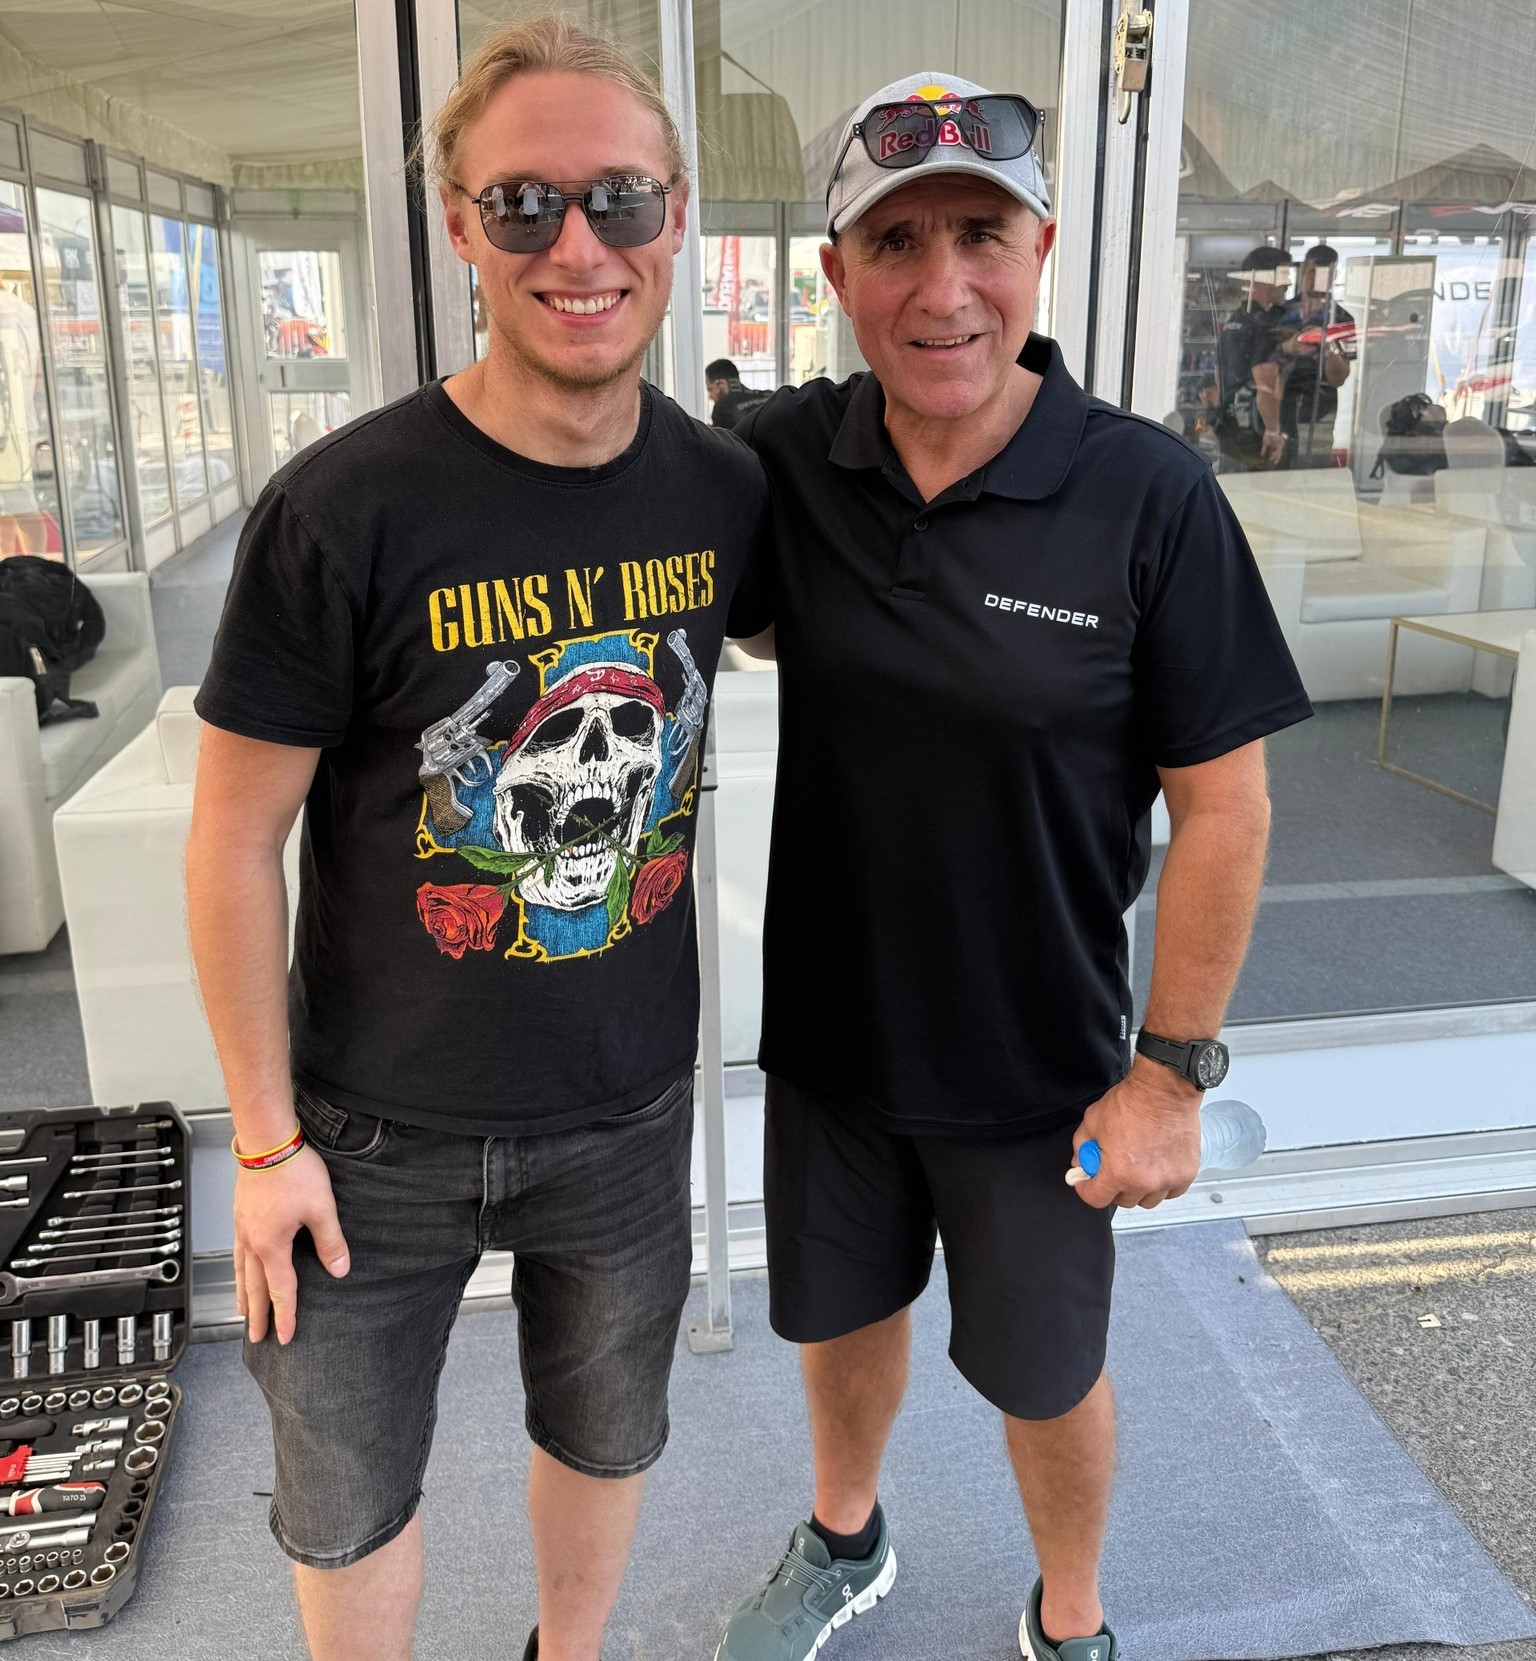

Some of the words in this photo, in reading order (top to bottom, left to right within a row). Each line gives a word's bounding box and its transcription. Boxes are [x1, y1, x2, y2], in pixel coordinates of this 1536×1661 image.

[880, 119, 935, 160] Red
[429, 574, 552, 652] GUNS
[564, 566, 604, 629] N'
[619, 550, 715, 621] ROSES
[984, 593, 1099, 629] DEFENDER
[62, 1494, 79, 1502] YATO
